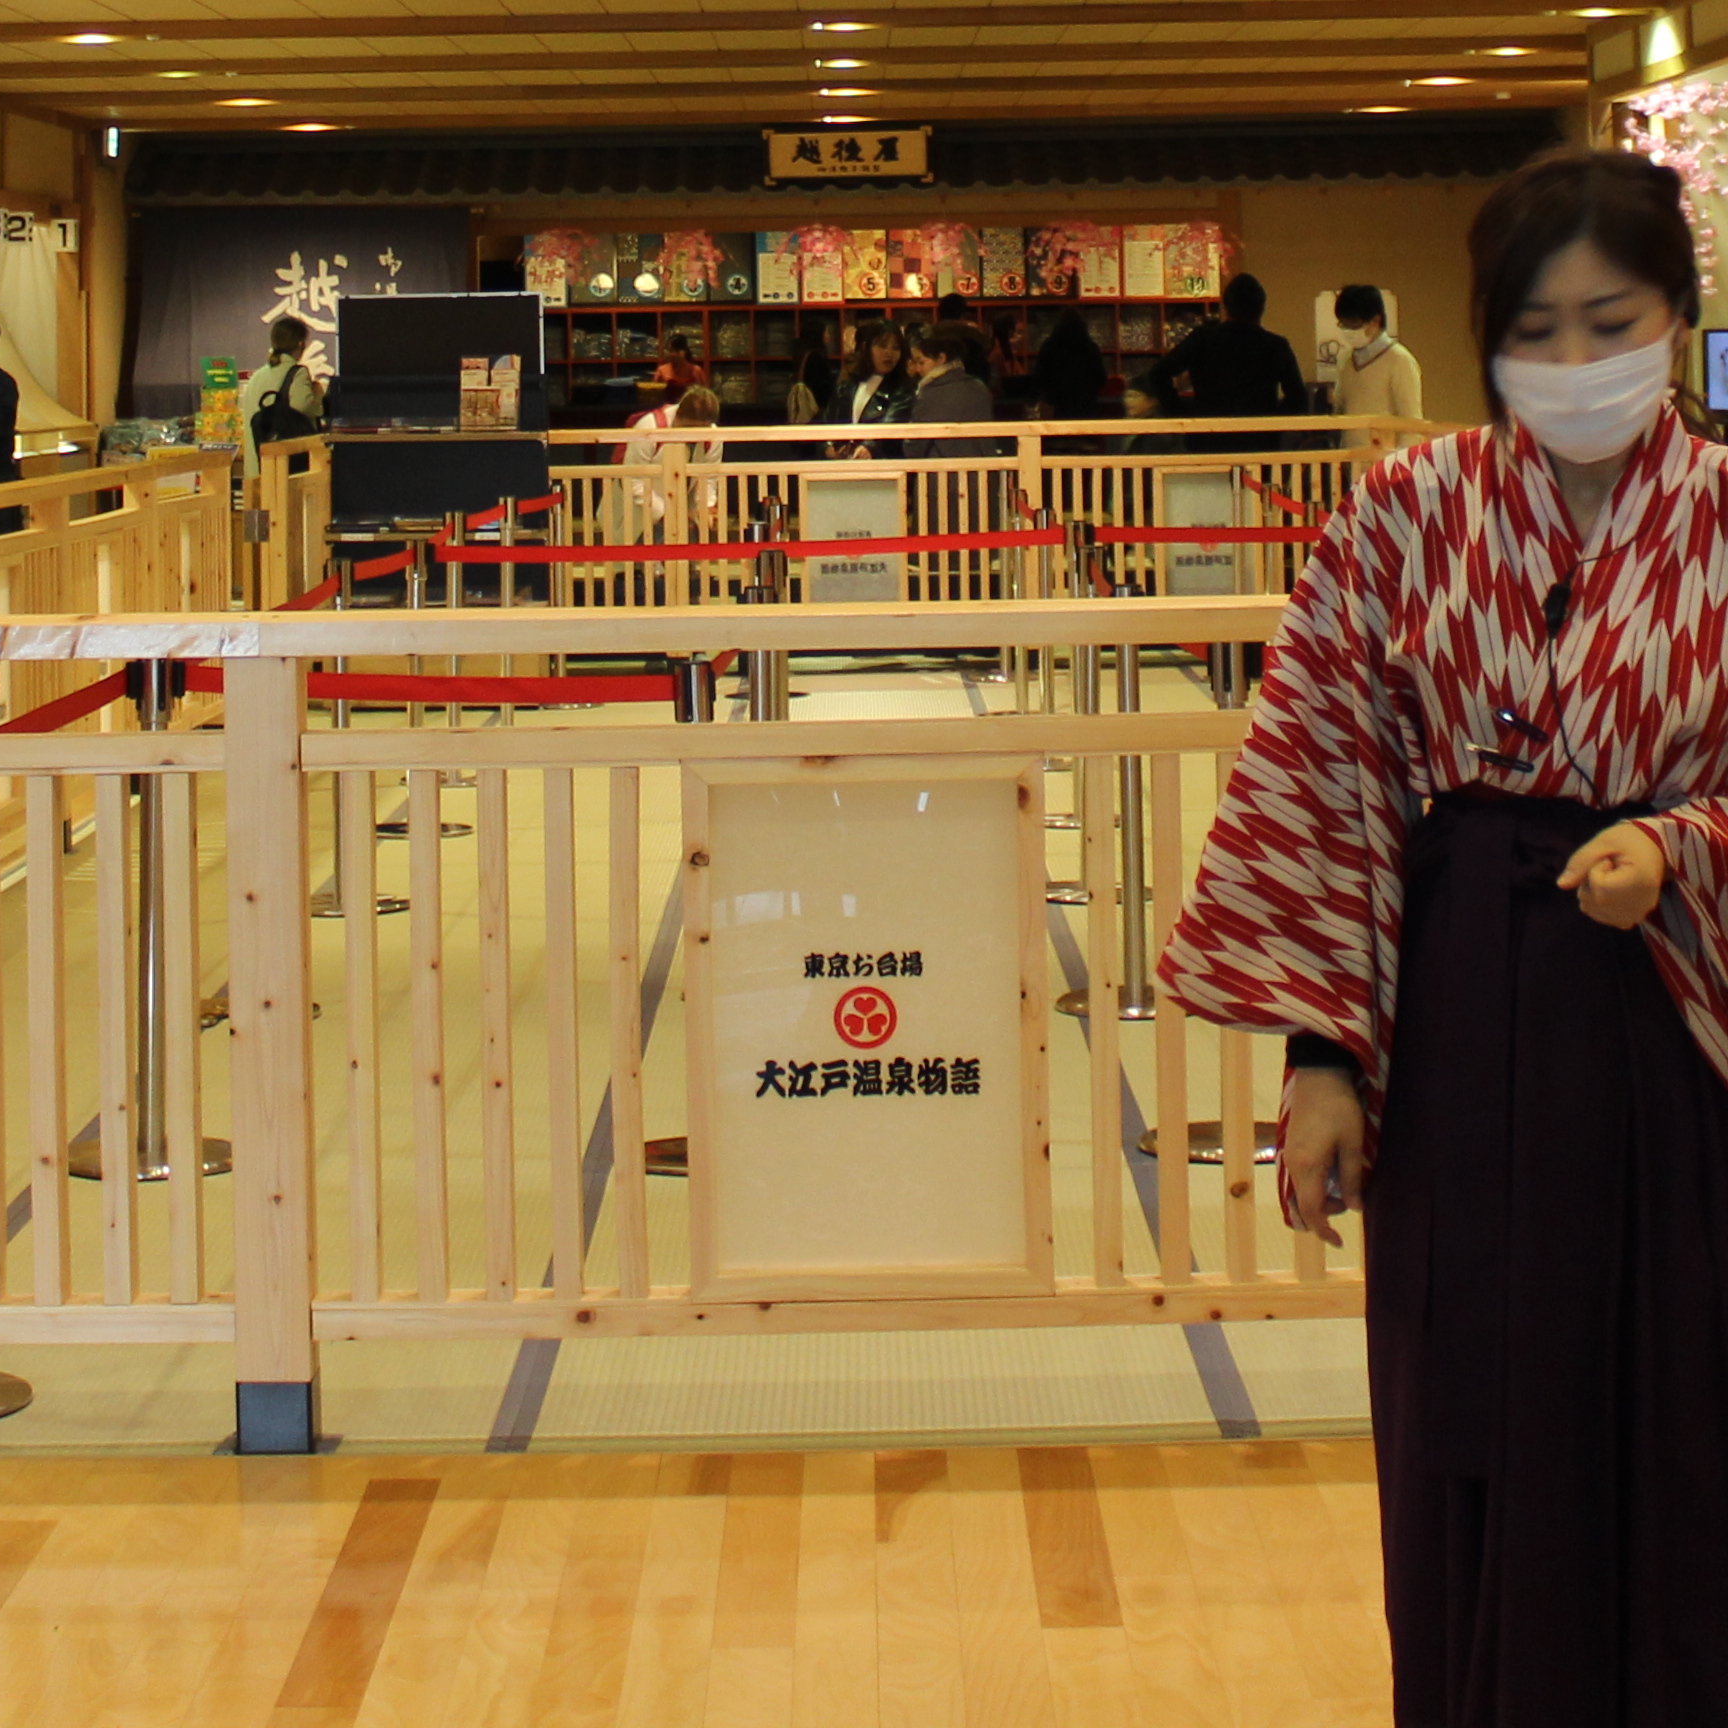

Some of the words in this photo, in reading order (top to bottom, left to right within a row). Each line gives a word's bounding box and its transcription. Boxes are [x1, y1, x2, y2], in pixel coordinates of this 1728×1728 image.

[8, 215, 26, 242] 2
[57, 223, 67, 248] 1
[803, 951, 923, 978] 東京お台場
[756, 1057, 981, 1099] 大江戸温泉物語
